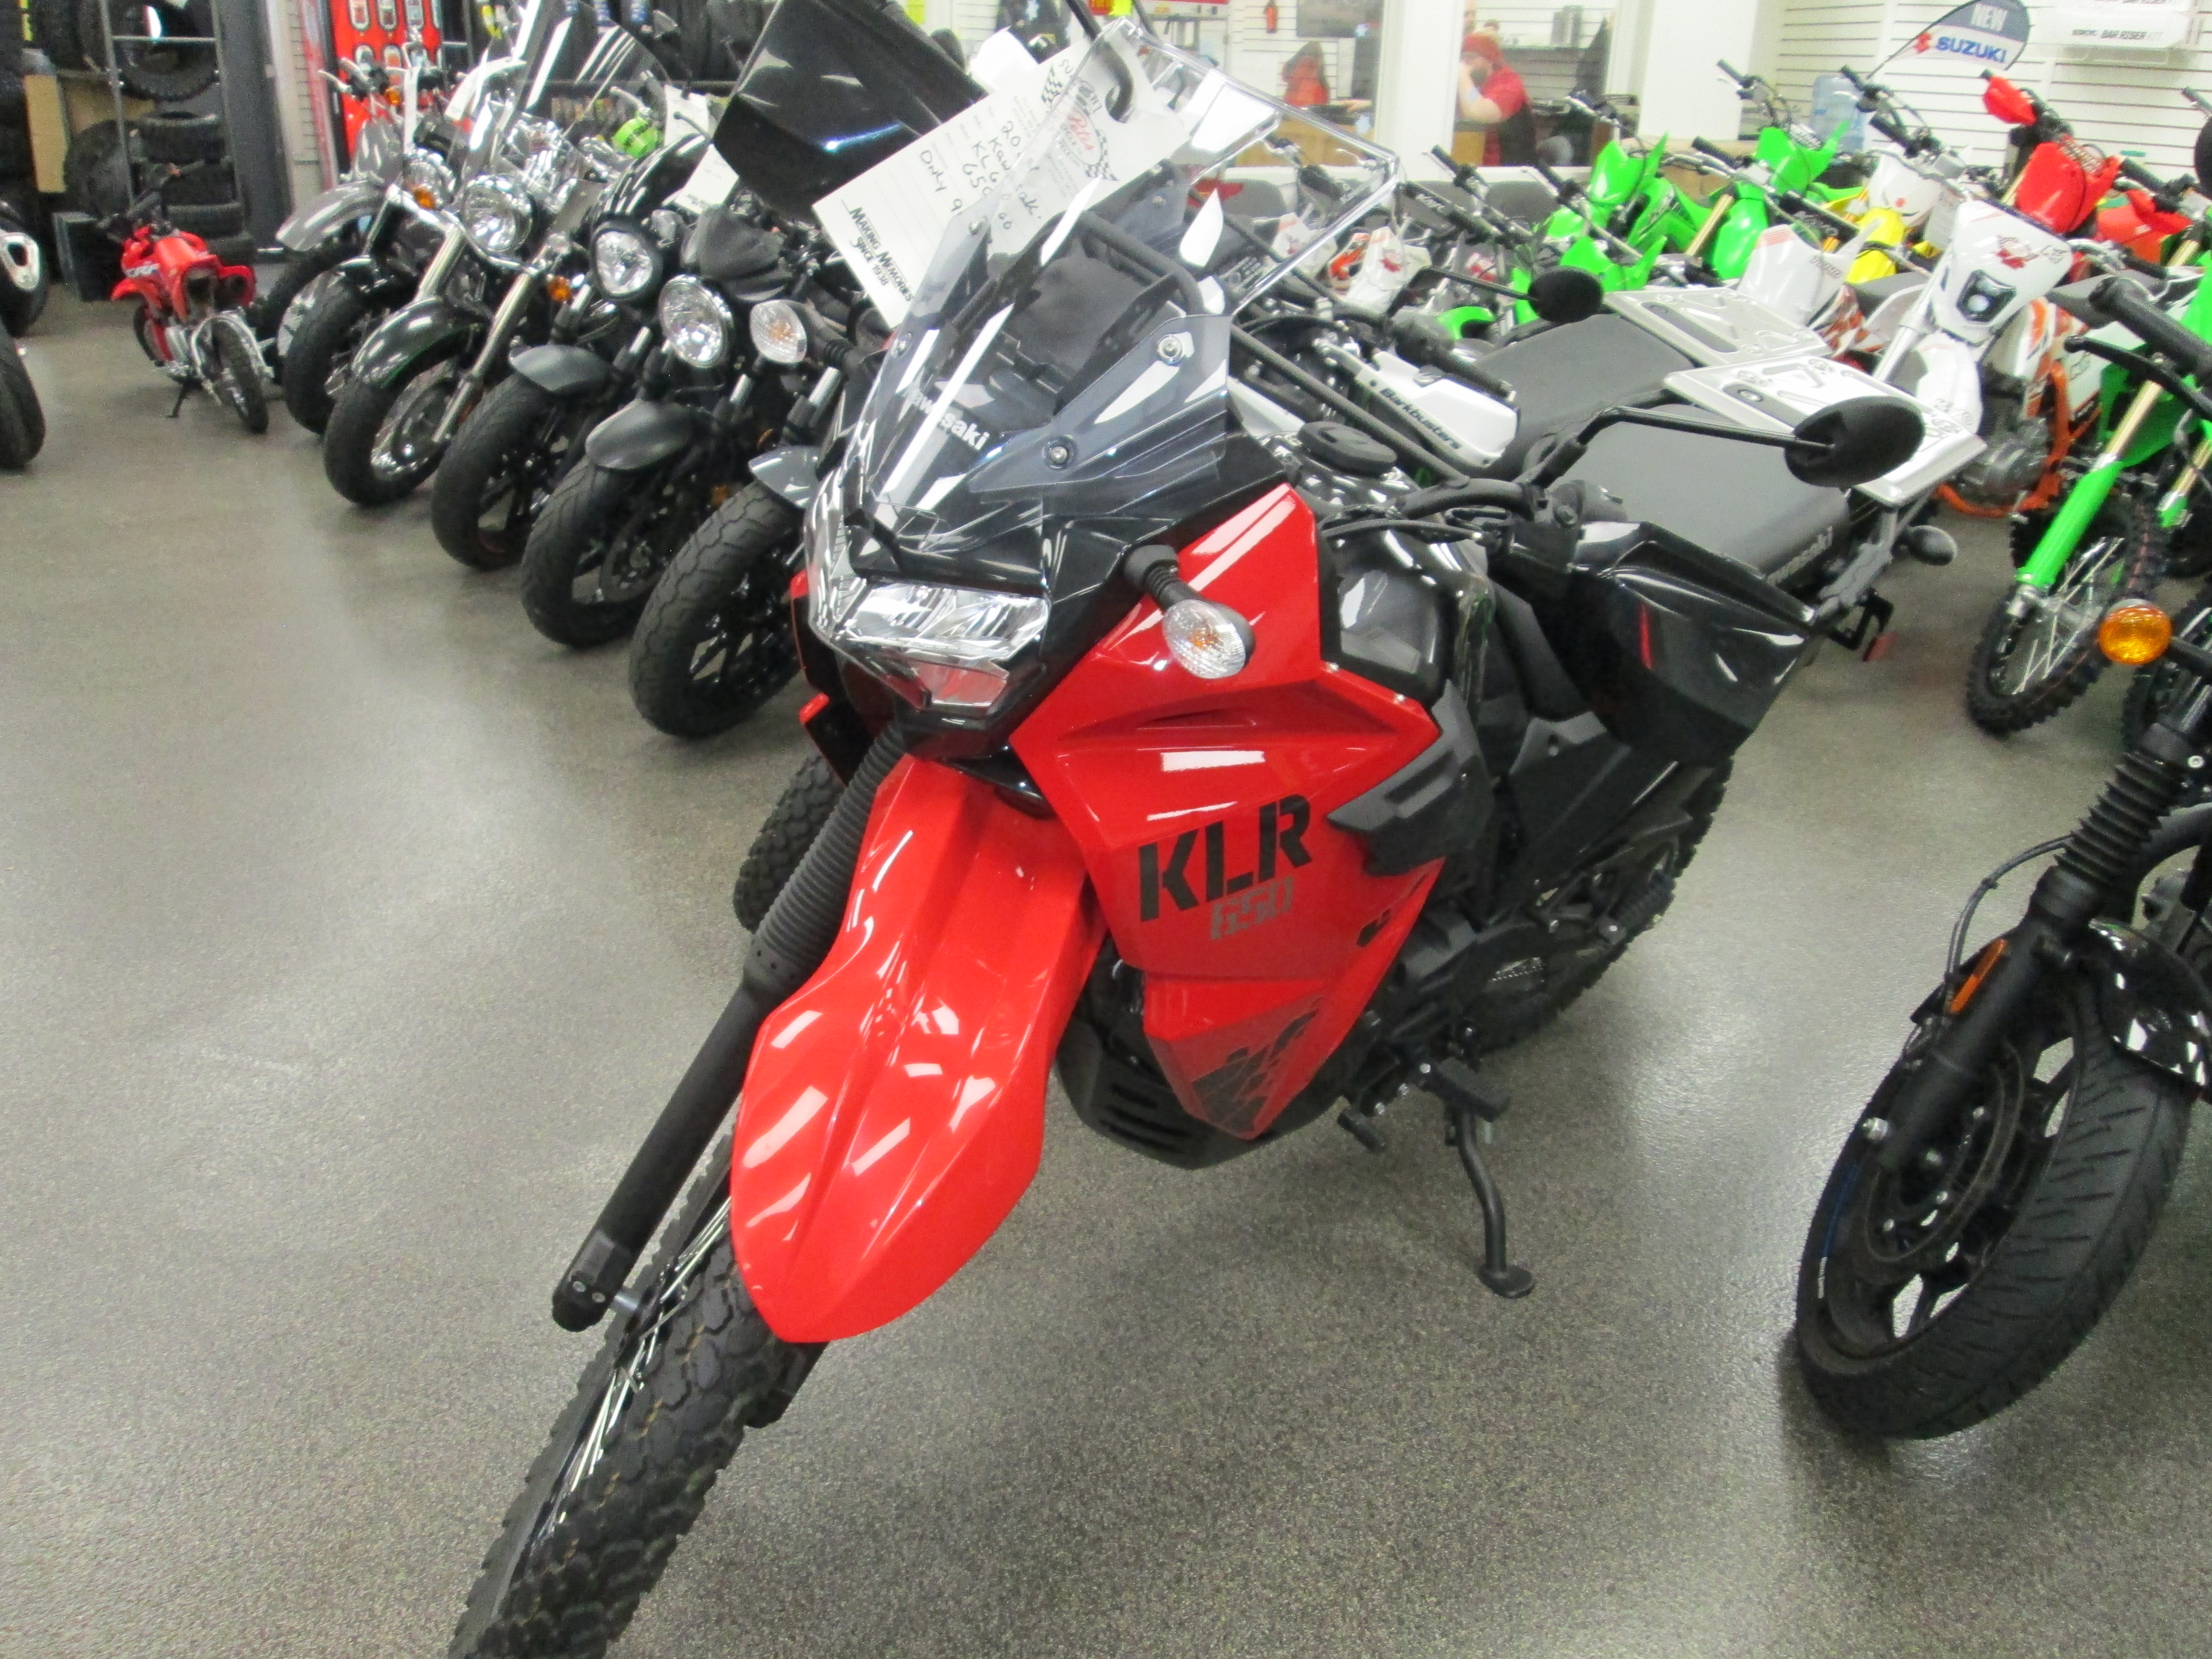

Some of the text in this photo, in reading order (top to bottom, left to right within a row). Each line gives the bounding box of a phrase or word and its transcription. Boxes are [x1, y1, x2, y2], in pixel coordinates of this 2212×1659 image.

[1971, 3, 2008, 32] NEW
[1935, 36, 2008, 63] SUZUKI
[849, 206, 914, 302] MAKING MEMORIES
[853, 236, 889, 287] SINCE 1938
[903, 386, 990, 450] awsaki
[1380, 387, 1462, 450] Barkbusters
[1139, 793, 1312, 922] KLR
[1211, 876, 1294, 940] 650
